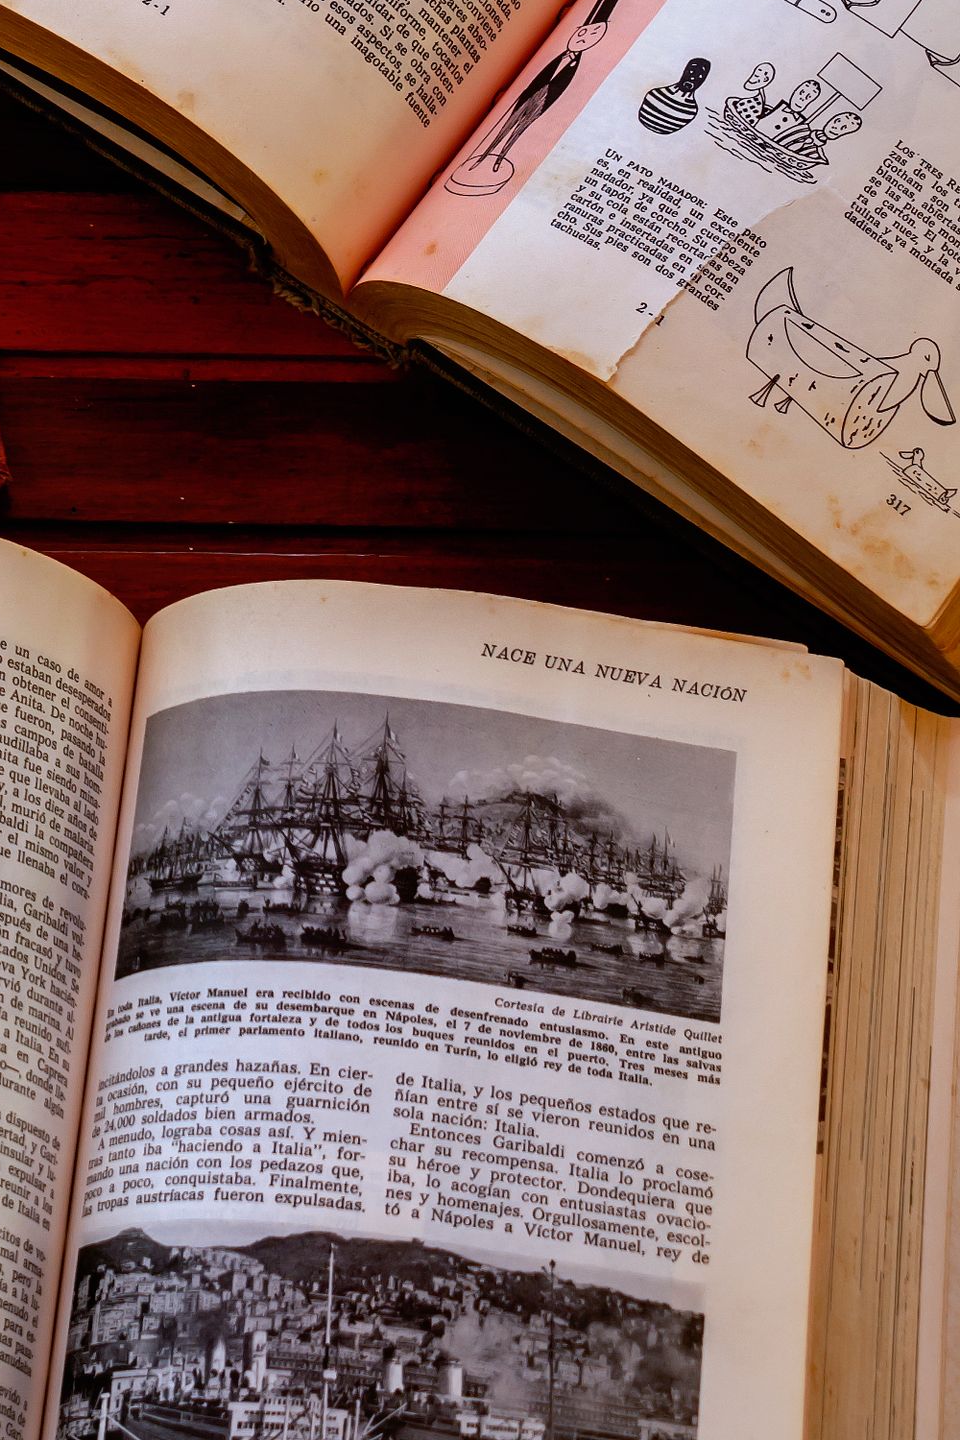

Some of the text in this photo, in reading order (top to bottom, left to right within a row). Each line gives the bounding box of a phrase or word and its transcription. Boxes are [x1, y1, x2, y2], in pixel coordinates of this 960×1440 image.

[604, 148, 767, 249] UN PATO NADADOR: Este pato
[550, 218, 601, 251] tachuelas.
[844, 210, 894, 253] dadientes.
[885, 493, 911, 517] 317
[480, 642, 746, 703] NACE UNA NUEVA NACIÓN
[494, 997, 723, 1045] Cortesía de Librairie Aristide Quillet
[91, 1120, 101, 1139] de
[140, 1106, 198, 1126] soldados
[204, 1106, 236, 1121] bien
[244, 1107, 315, 1125] armados.
[392, 1105, 540, 1139] sola nación: Italia.
[384, 1202, 710, 1265] tó a Nápoles a Víctor Manuel, rey de
